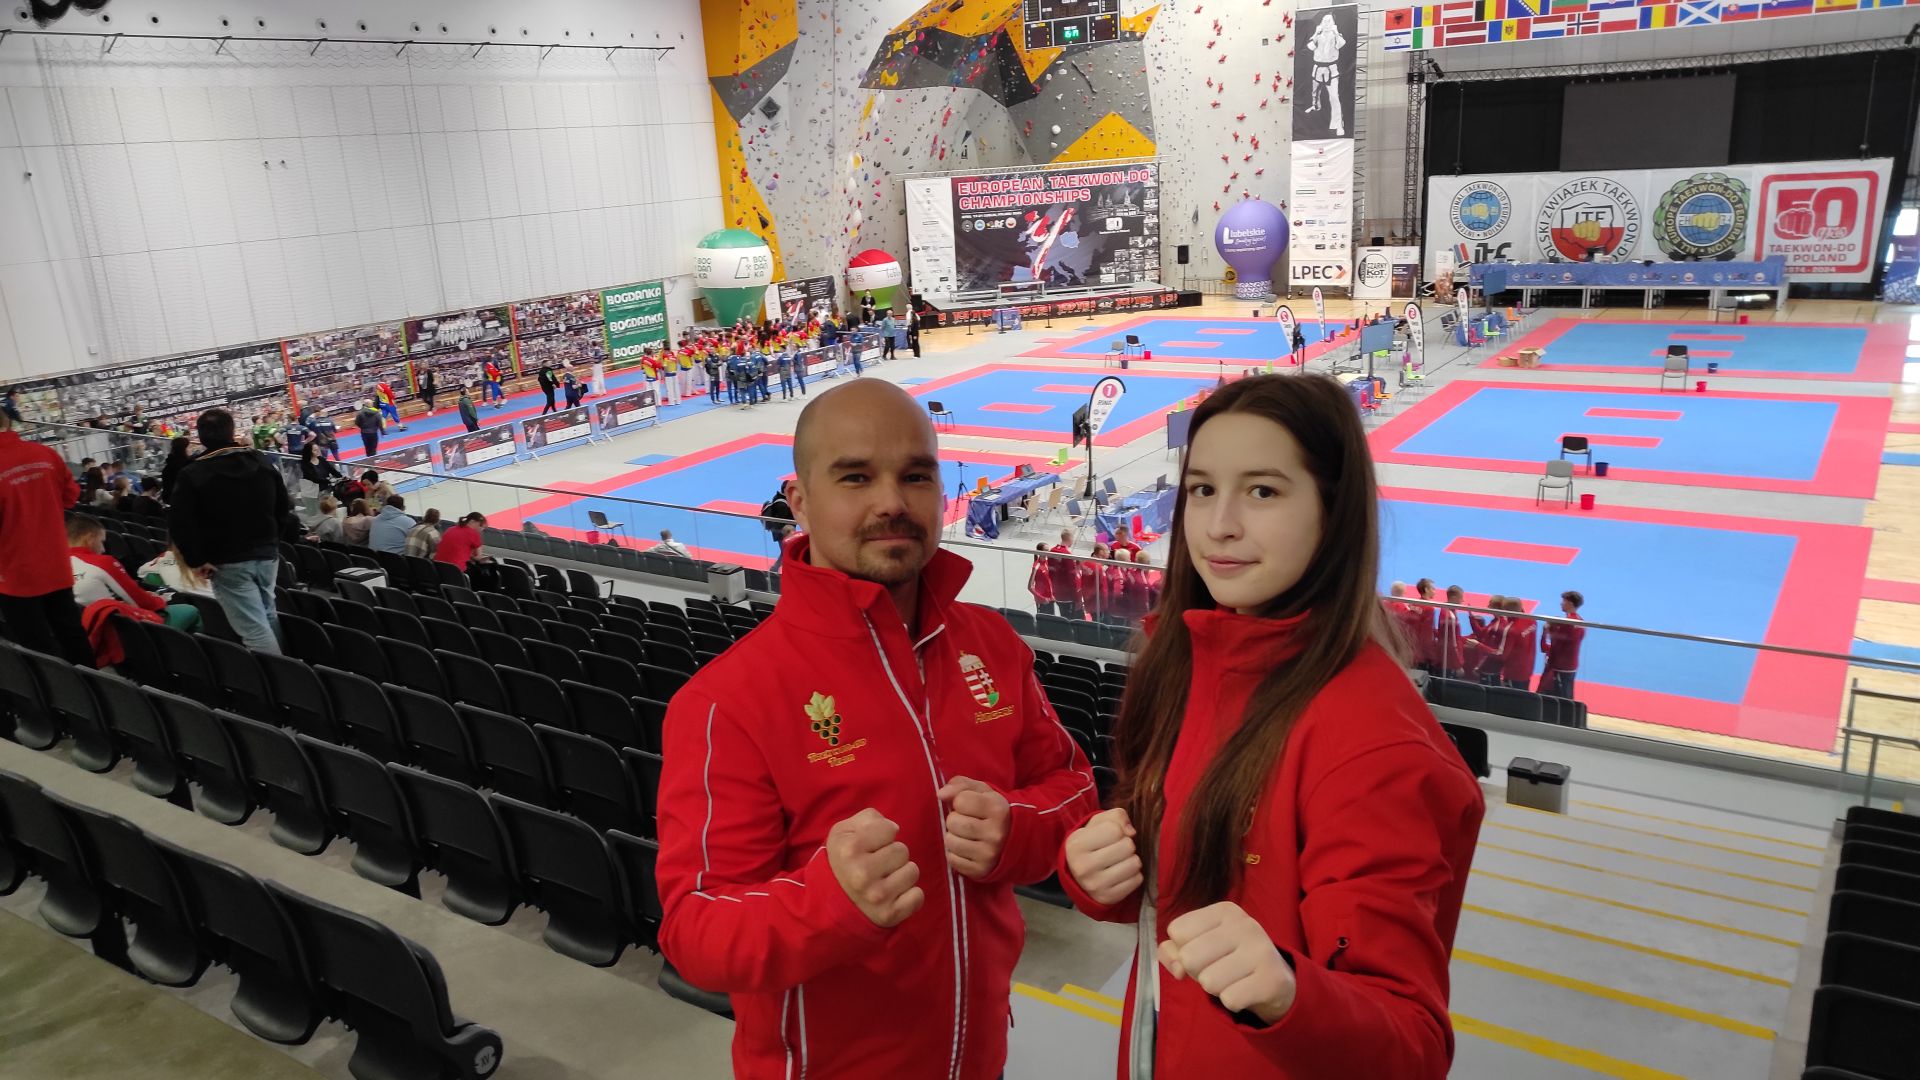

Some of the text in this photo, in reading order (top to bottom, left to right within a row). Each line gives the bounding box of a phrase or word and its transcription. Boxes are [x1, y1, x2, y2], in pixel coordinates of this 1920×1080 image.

[958, 169, 1150, 195] EUROPEAN TAEKWON-DO
[959, 188, 1091, 210] CHAMPIONSHIPS
[1452, 193, 1475, 237] INTERNATIONAL
[1575, 211, 1606, 224] ITF
[1666, 206, 1679, 244] EUROPE
[1675, 184, 1739, 204] TAEKWON-DO
[1708, 203, 1745, 254] FEDERATION
[1774, 186, 1858, 240] 50
[1223, 226, 1266, 245] Lubelskie
[1539, 221, 1557, 258] OLSKI
[1769, 243, 1856, 253] TAEKWON-DO
[1793, 253, 1847, 262] POLAND
[1292, 265, 1333, 280] LPEC
[606, 287, 662, 305] BOGDANKA
[610, 313, 664, 332] BOGDANKA
[1106, 385, 1113, 396] 1
